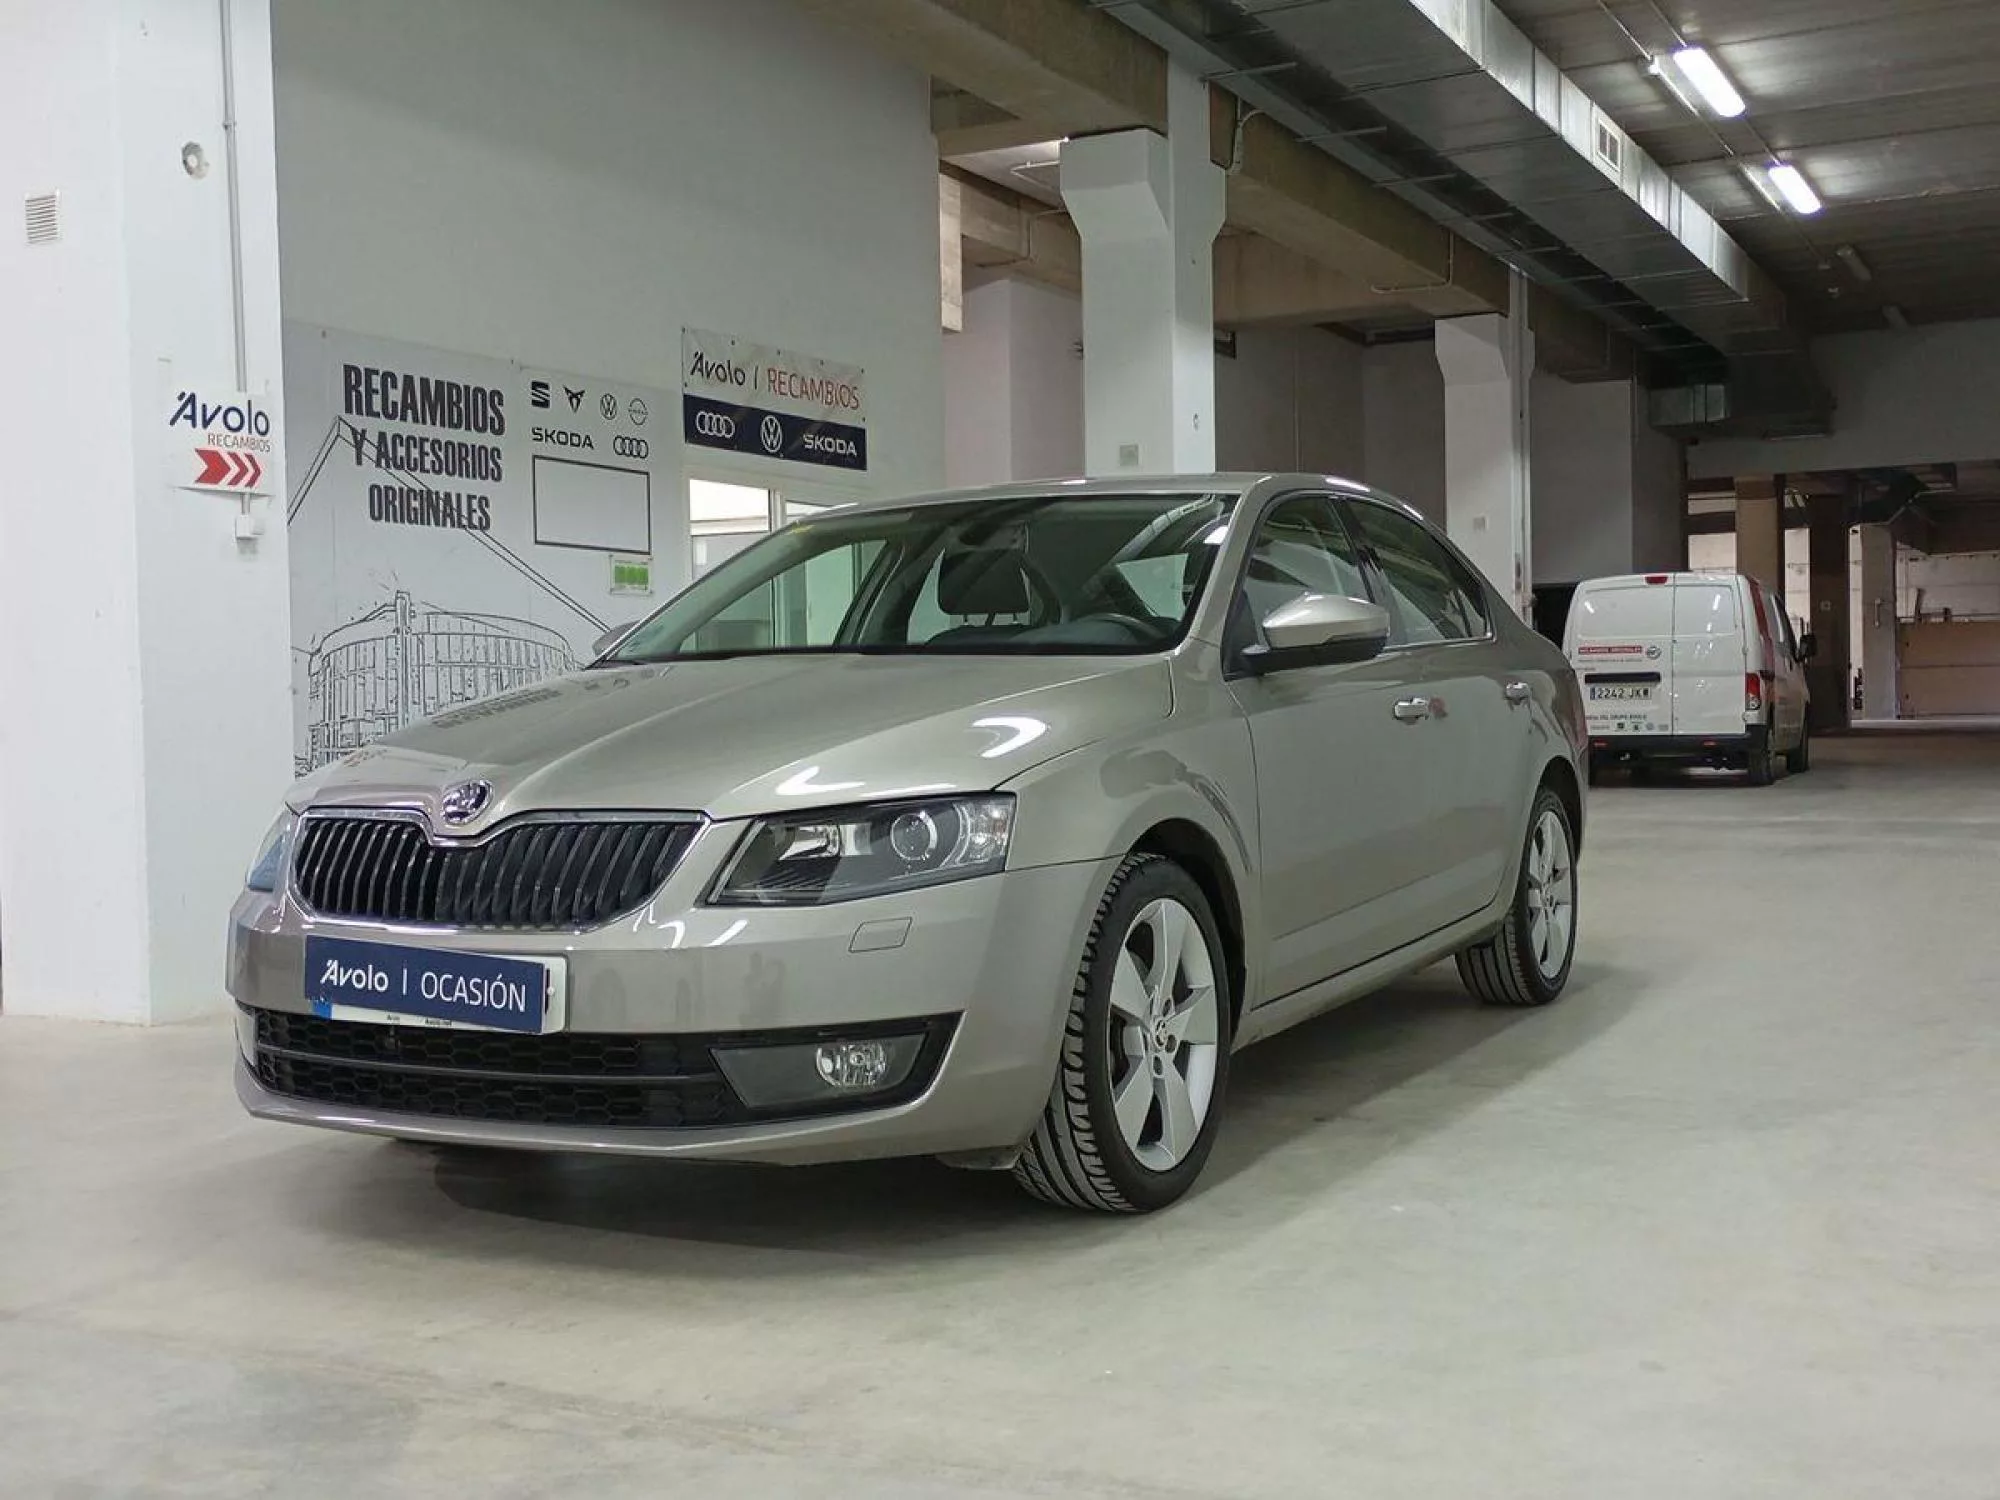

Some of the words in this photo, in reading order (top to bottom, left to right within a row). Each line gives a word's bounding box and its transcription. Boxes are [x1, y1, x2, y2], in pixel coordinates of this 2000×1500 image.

[343, 364, 506, 436] RECAMBIOS
[767, 368, 860, 411] RECAMBIOS
[207, 433, 271, 452] RECAMBIOS
[350, 427, 368, 466] Y
[374, 431, 503, 482] ACCESORIOS
[531, 426, 595, 450] SKODA
[803, 434, 857, 457] SKODA
[368, 484, 491, 531] ORIGINALES
[421, 971, 526, 1012] OCASIÓN
